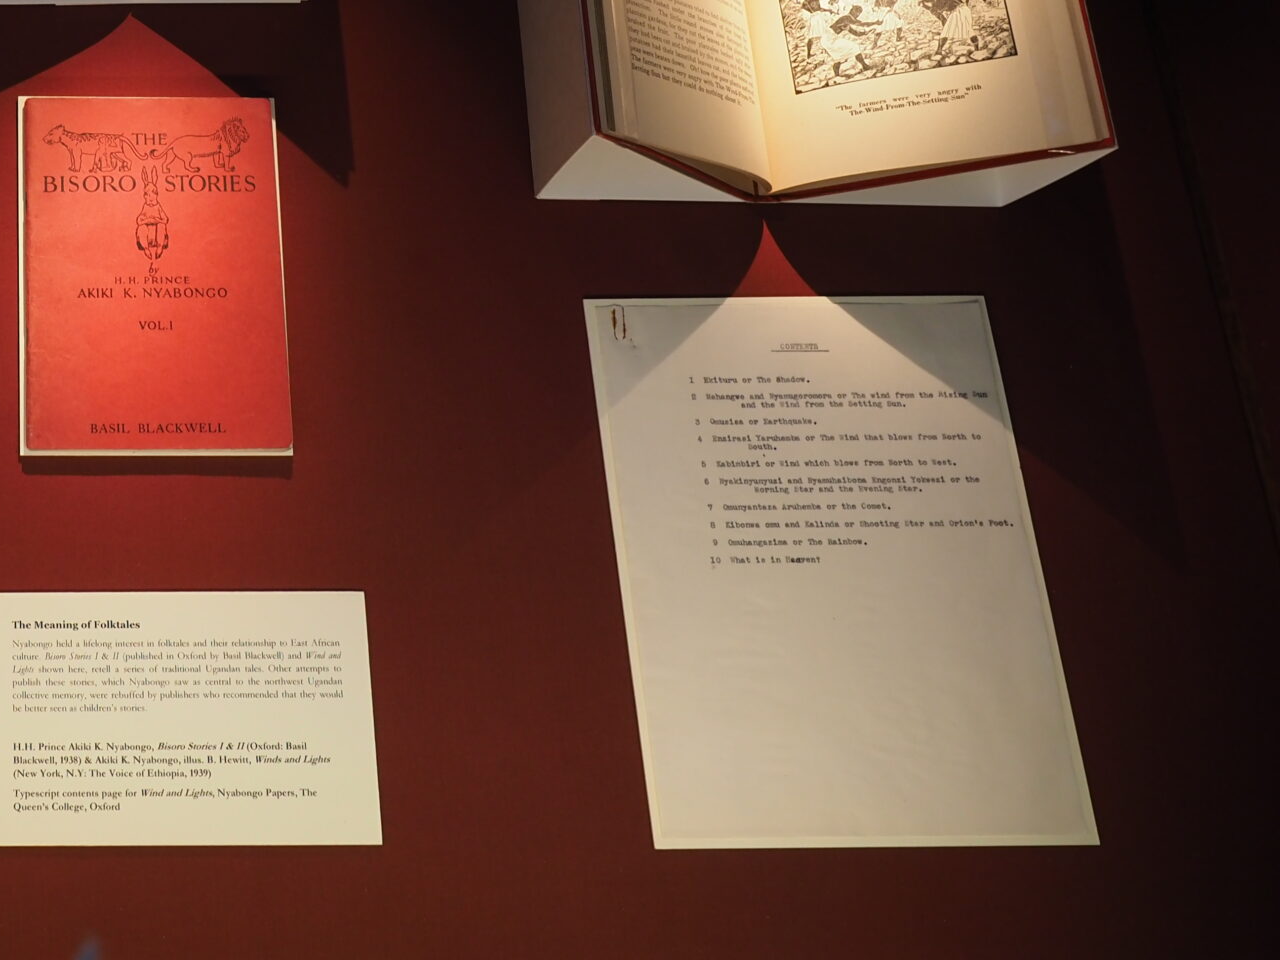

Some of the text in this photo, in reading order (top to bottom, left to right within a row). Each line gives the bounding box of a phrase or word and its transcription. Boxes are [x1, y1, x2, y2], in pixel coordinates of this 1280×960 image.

[858, 98, 887, 109] farmers
[892, 95, 909, 103] were
[915, 91, 931, 101] very
[937, 87, 959, 97] angry
[965, 83, 982, 93] with
[131, 132, 169, 146] THE
[42, 174, 257, 194] BISORO STORIES
[148, 262, 160, 277] by
[144, 276, 190, 285] PRINCE
[77, 286, 228, 299] AKIKI K. NYABONGO
[89, 422, 226, 434] BASIL BLACKWELL
[11, 619, 141, 632] The Meaning of Folktales
[13, 768, 38, 780] (New
[39, 768, 64, 779] York,
[88, 768, 107, 778] The
[108, 768, 134, 778] Voice
[135, 768, 146, 778] of
[147, 768, 188, 780] Ethiopia,
[189, 768, 212, 780] 1939)
[13, 788, 318, 801] Typescript contents page for Wind and Lights, Nyabongo Papers, The
[13, 801, 121, 814] Queen's College, Oxford
